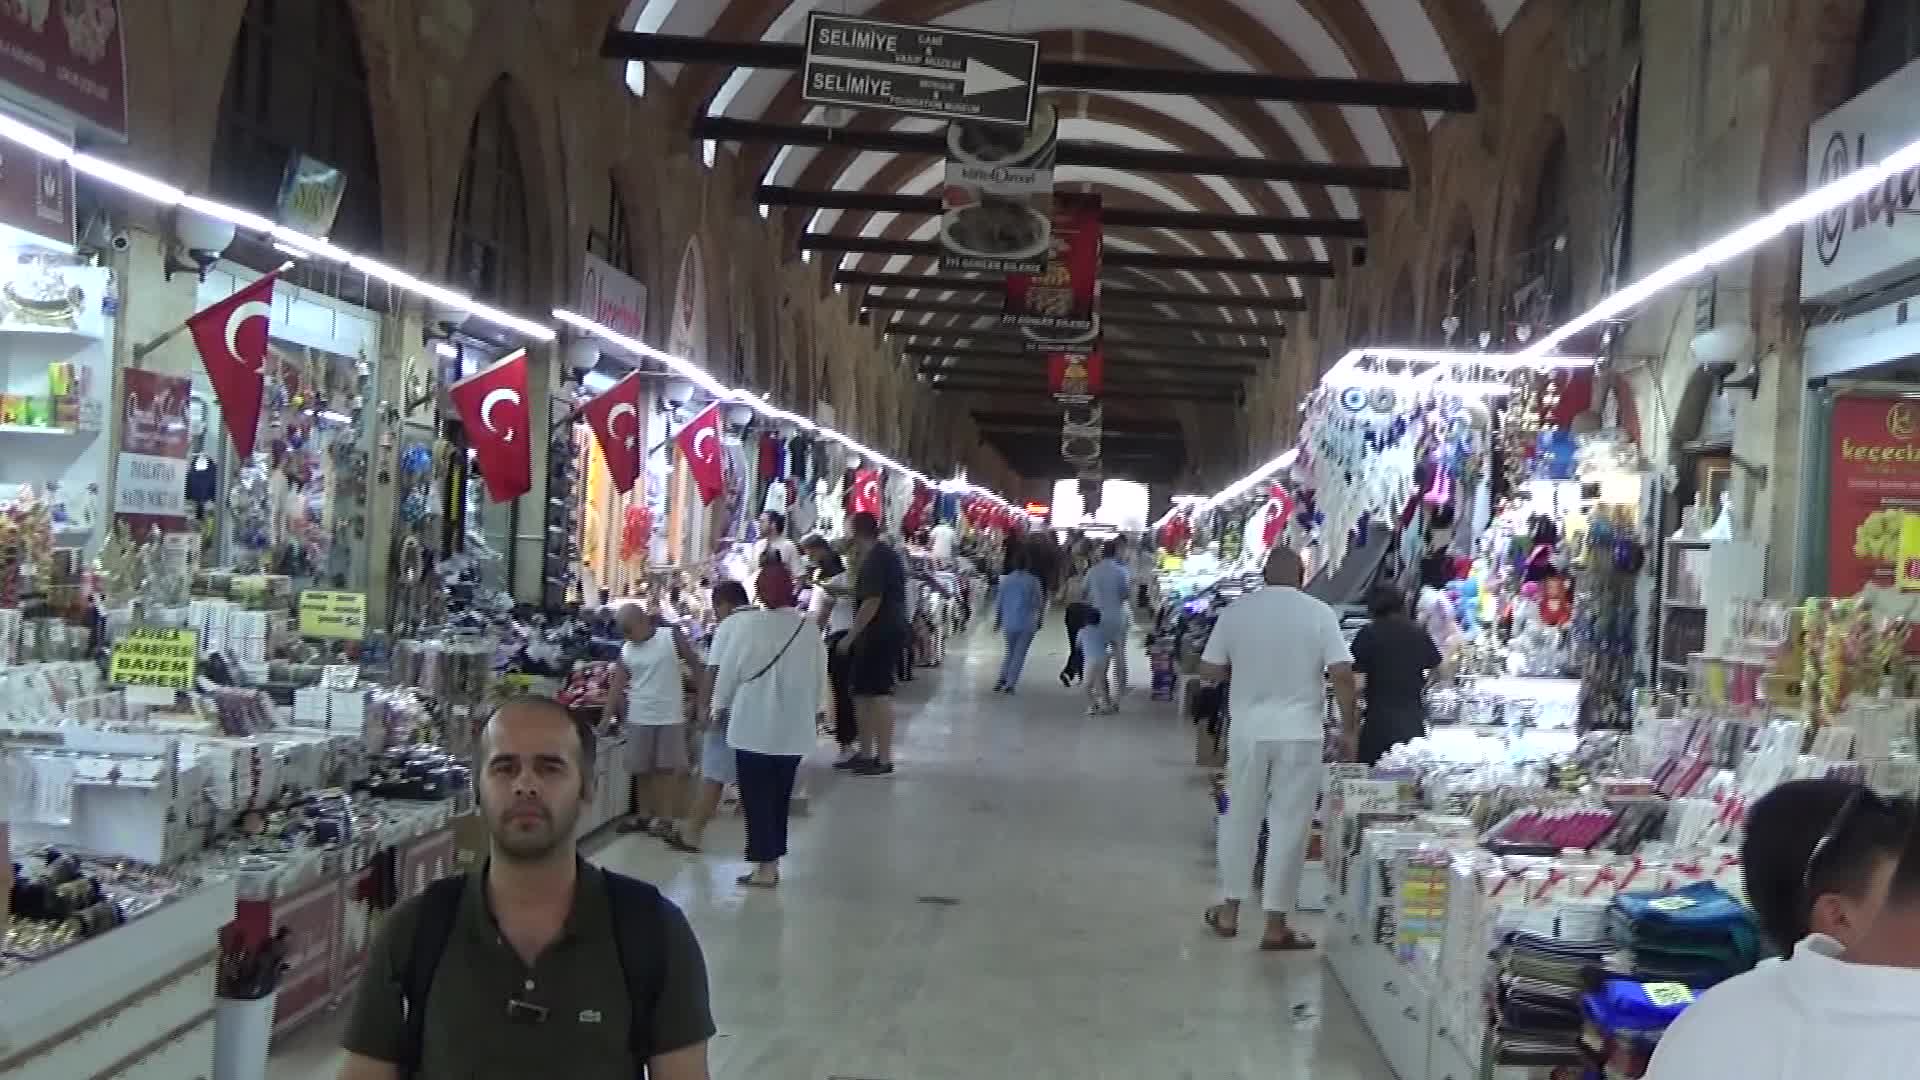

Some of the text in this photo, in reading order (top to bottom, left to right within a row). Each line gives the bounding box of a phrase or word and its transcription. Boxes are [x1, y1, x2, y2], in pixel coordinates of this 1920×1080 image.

[818, 28, 896, 51] SELİMİYE
[813, 73, 892, 96] SELİMİYE
[944, 102, 981, 114] MUSEUM
[118, 658, 189, 673] BADEM
[114, 672, 189, 688] EZMESİ
